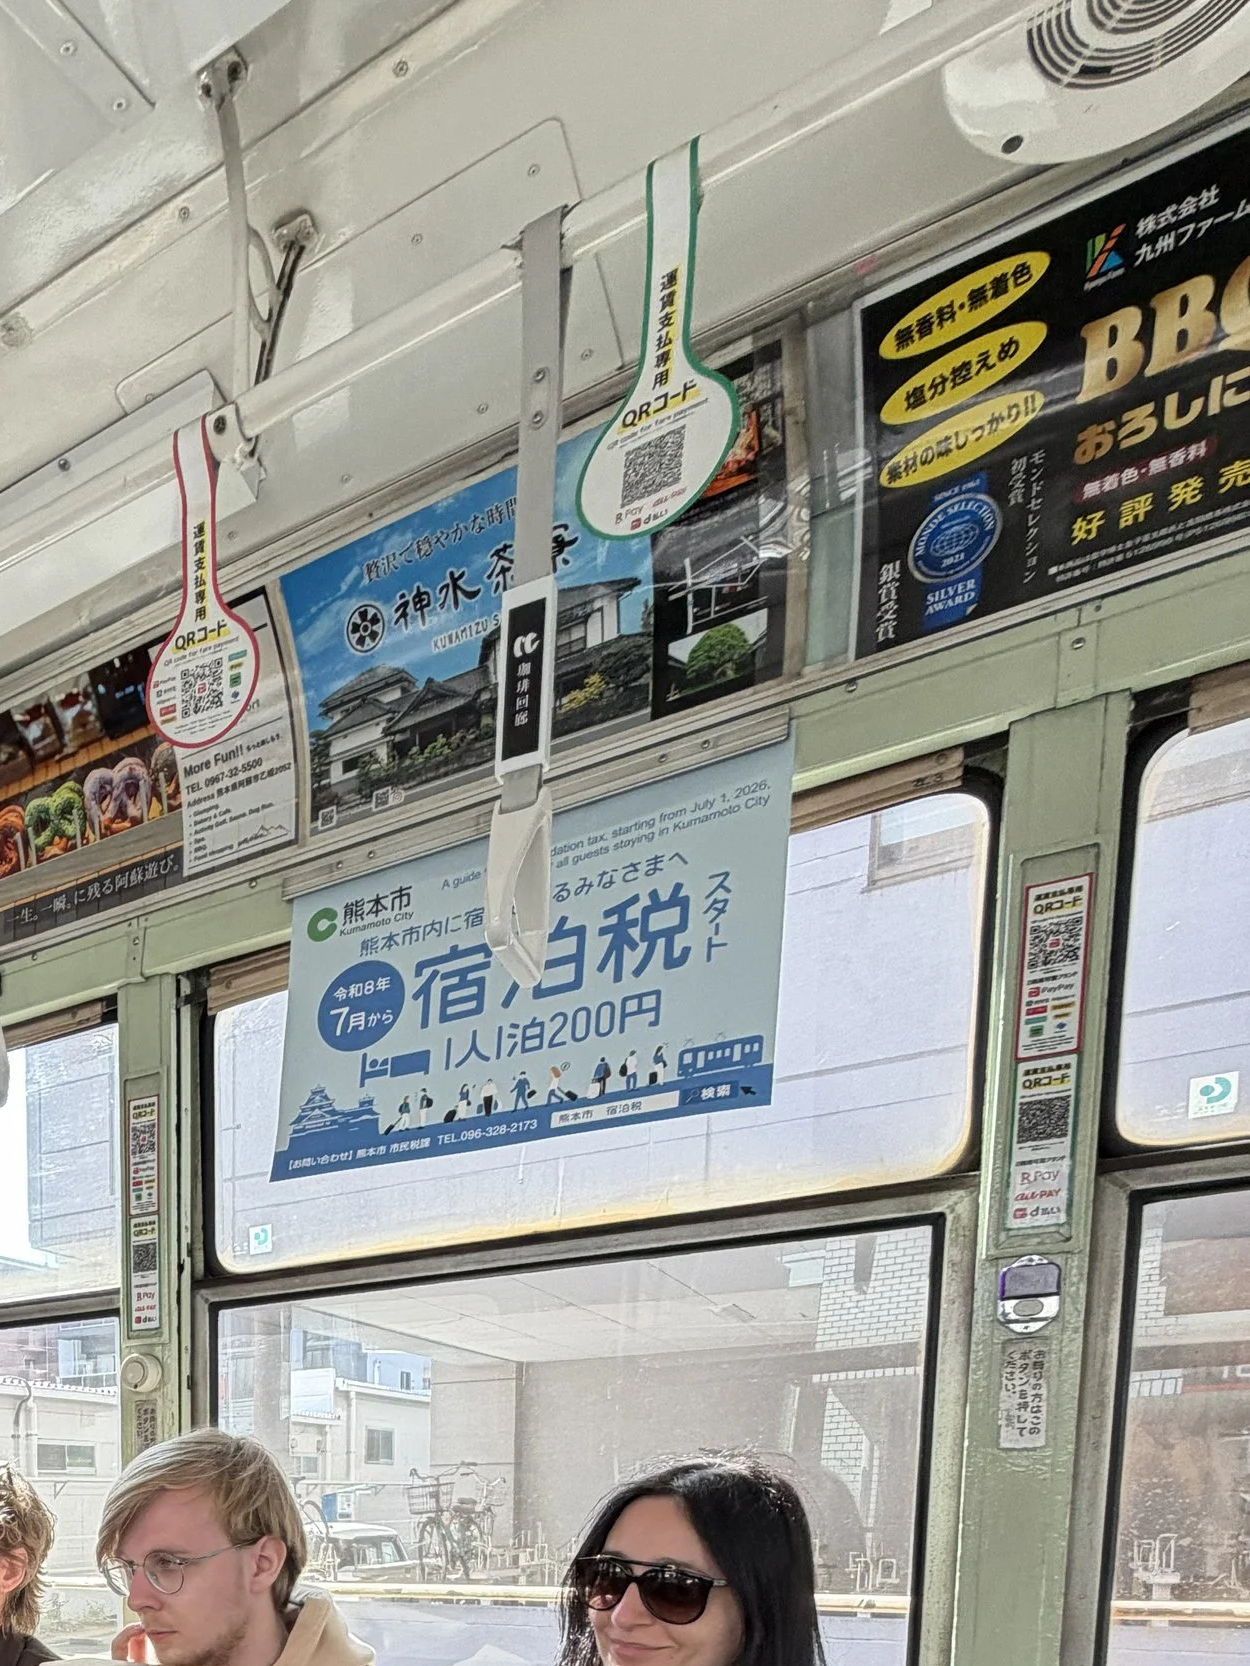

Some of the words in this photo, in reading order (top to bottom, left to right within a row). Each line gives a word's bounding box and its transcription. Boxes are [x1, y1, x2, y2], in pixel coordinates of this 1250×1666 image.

[1133, 198, 1250, 268] 九州ファーム
[1136, 184, 1220, 239] 株式会社
[652, 268, 678, 391] 運賃支払専用
[893, 261, 1033, 353] 無香料・無着色
[904, 336, 1020, 412] 塩分控えめ
[622, 379, 697, 429] QRコード
[1073, 367, 1250, 465] おろしに
[1008, 456, 1028, 507] 初受賞
[1082, 439, 1207, 500] 無着色・無香料
[916, 514, 947, 556] MONDE
[948, 500, 996, 532] SELECTION
[1023, 450, 1046, 584] モンドセレクション
[193, 521, 206, 622] 運賃支払専用
[926, 579, 976, 604] SILVER
[875, 560, 901, 643] 銀賞受賞
[925, 591, 976, 616] AWARD
[175, 619, 228, 650] QRコード
[184, 759, 212, 778] More
[214, 744, 244, 766] Fun!!
[185, 782, 203, 796] TEL
[205, 757, 263, 788] 0967-32-5500
[556, 857, 570, 869] all
[572, 846, 610, 866] guests
[613, 831, 656, 853] staying
[658, 826, 669, 838] in
[673, 805, 742, 831] Kumamoto
[745, 794, 771, 812] City
[612, 817, 655, 839] starting
[659, 808, 687, 824] from
[690, 795, 716, 814] July
[442, 879, 451, 890] A
[453, 871, 481, 888] guide
[553, 852, 688, 903] るみなさまへ
[340, 917, 391, 937] Kumamoto
[394, 911, 415, 924] City
[342, 885, 413, 926] 熊本市
[703, 871, 732, 963] スタート
[1034, 896, 1082, 916] QRコード
[360, 907, 486, 957] 熊本市内に宿
[412, 881, 692, 1030] 宿泊税
[334, 976, 391, 1002] 令和8年
[329, 1006, 394, 1037] 7月から
[700, 1084, 732, 1099] 検索
[1022, 1072, 1071, 1090] QRコード
[558, 1109, 594, 1125] 熊本市
[606, 1101, 643, 1116] 宿泊税
[356, 1144, 387, 1160] 熊本市
[389, 1137, 431, 1156] 市民税課
[437, 1119, 538, 1146] TEL.096-328-2173
[1034, 1170, 1060, 1184] Pay
[1039, 1188, 1062, 1200] PAY
